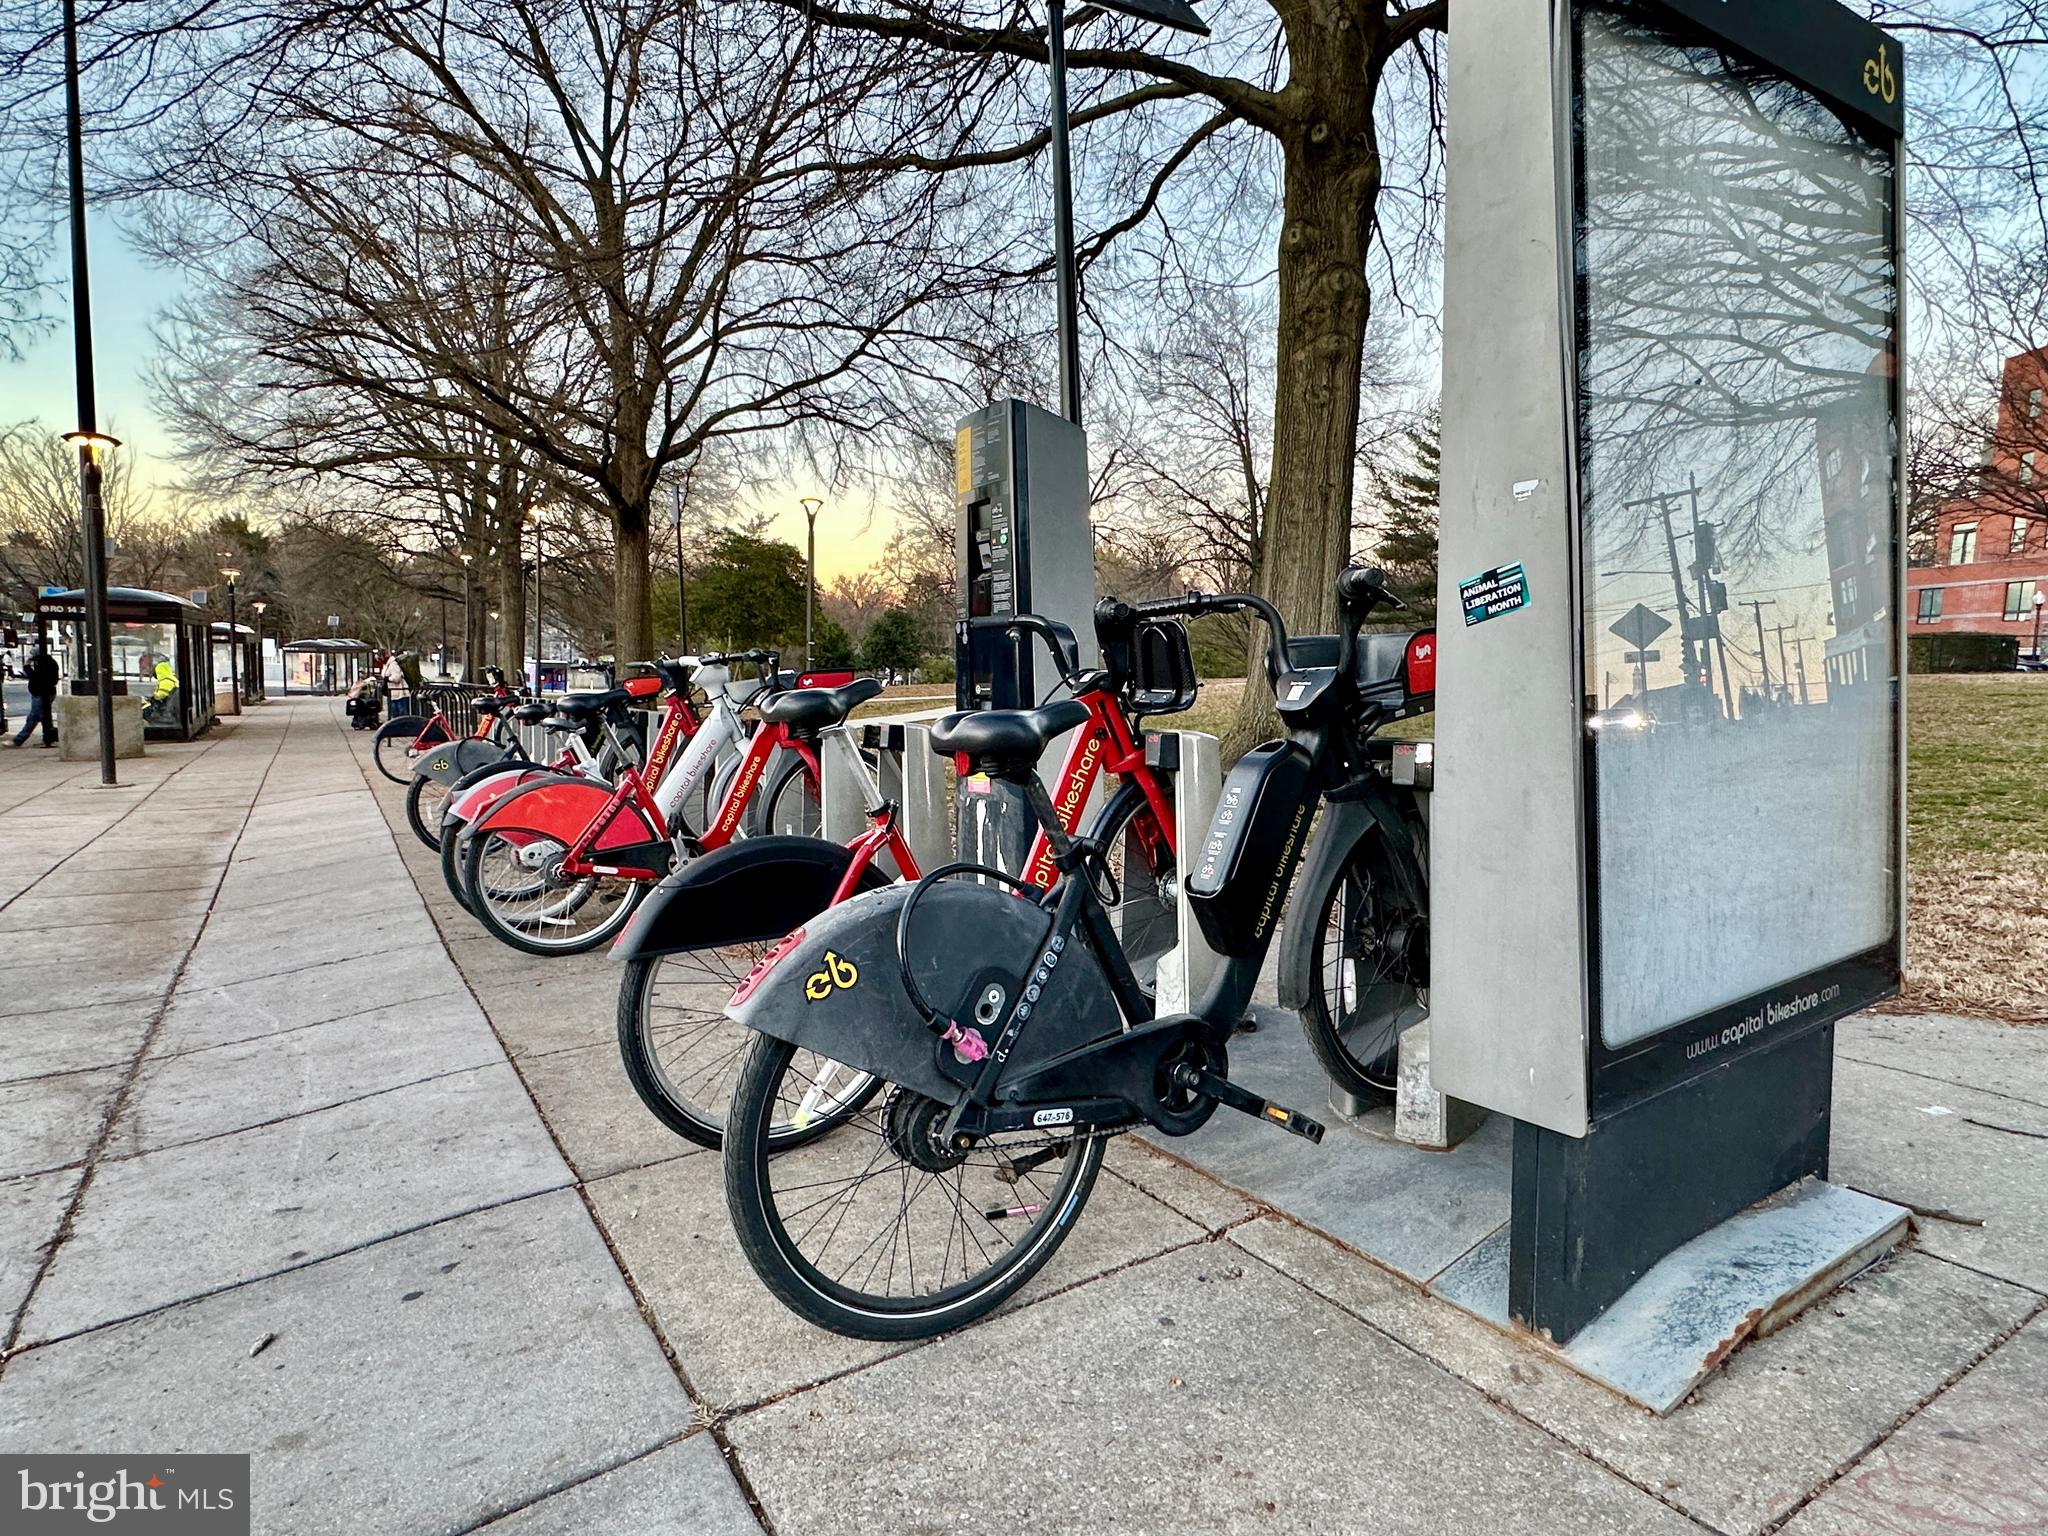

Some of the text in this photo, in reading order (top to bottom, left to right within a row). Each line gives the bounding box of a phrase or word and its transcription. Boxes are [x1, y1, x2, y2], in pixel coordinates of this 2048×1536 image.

[1463, 579, 1498, 599] ANIMAL
[1465, 582, 1521, 610] LIBERATION
[1487, 595, 1522, 615] MONTH
[669, 739, 717, 808] capital bikeshare
[721, 755, 761, 832] capital bikeshare
[1037, 1111, 1071, 1123] 647-576
